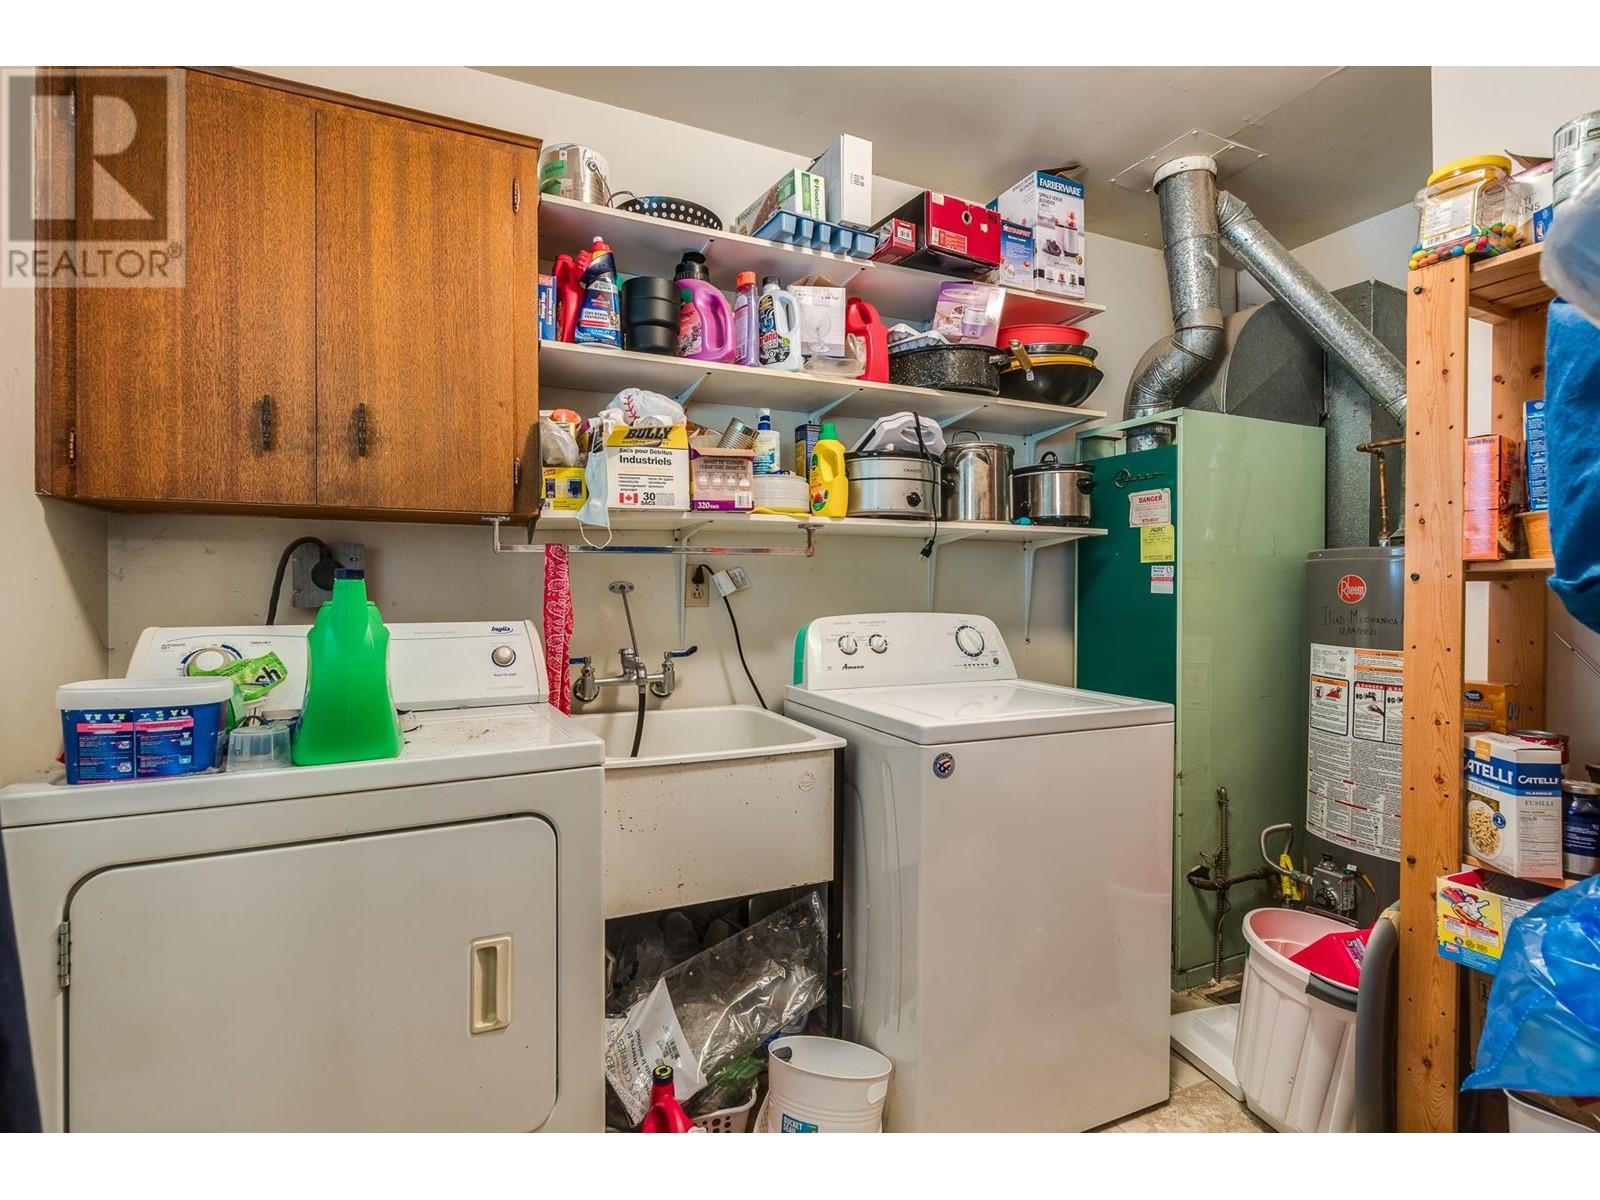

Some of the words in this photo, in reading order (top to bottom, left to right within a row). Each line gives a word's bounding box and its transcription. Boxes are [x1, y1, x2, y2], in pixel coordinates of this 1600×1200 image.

[1039, 178, 1082, 197] FARBERWARE
[624, 426, 673, 440] BULLY
[619, 455, 672, 466] Industriels
[643, 492, 656, 501] 30
[1138, 495, 1163, 504] DANGER
[697, 501, 710, 509] 320
[1340, 575, 1365, 600] Rheem
[1466, 759, 1513, 785] ATELLI
[1518, 775, 1560, 785] CATELLI
